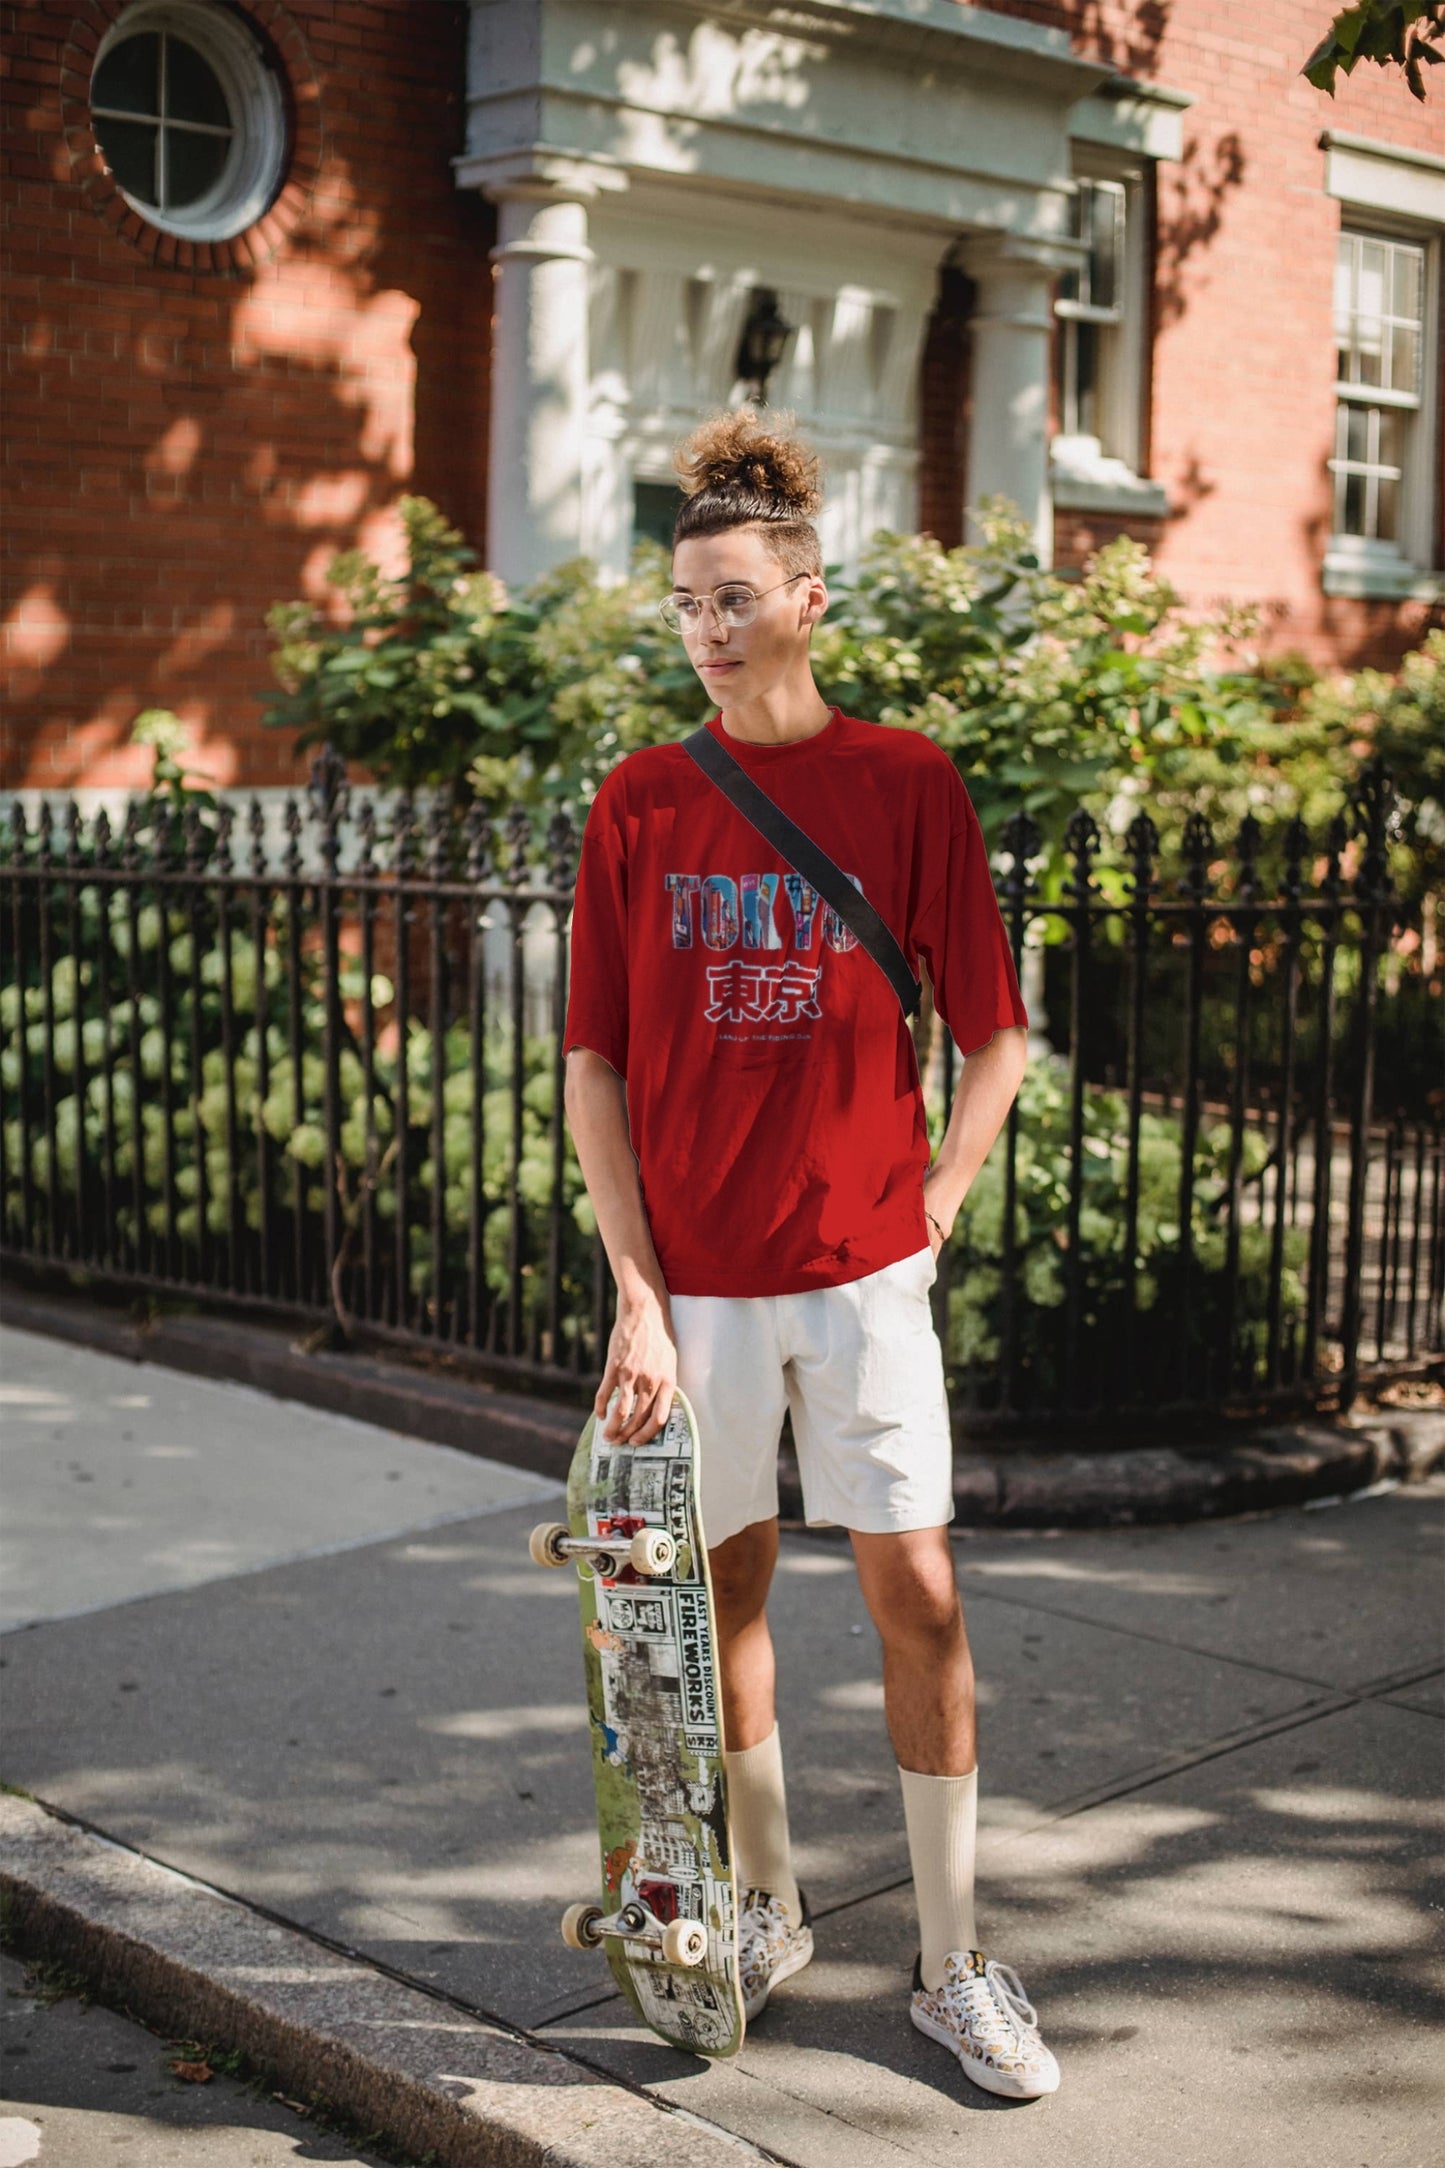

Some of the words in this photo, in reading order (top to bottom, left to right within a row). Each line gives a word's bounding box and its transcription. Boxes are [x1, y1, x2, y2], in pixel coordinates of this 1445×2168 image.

[704, 960, 822, 1023] 東京
[696, 1593, 708, 1621] LAST
[679, 1593, 705, 1722] FIREWORKS
[699, 1627, 711, 1662] YEARS
[703, 1666, 716, 1720] DISCOUNT
